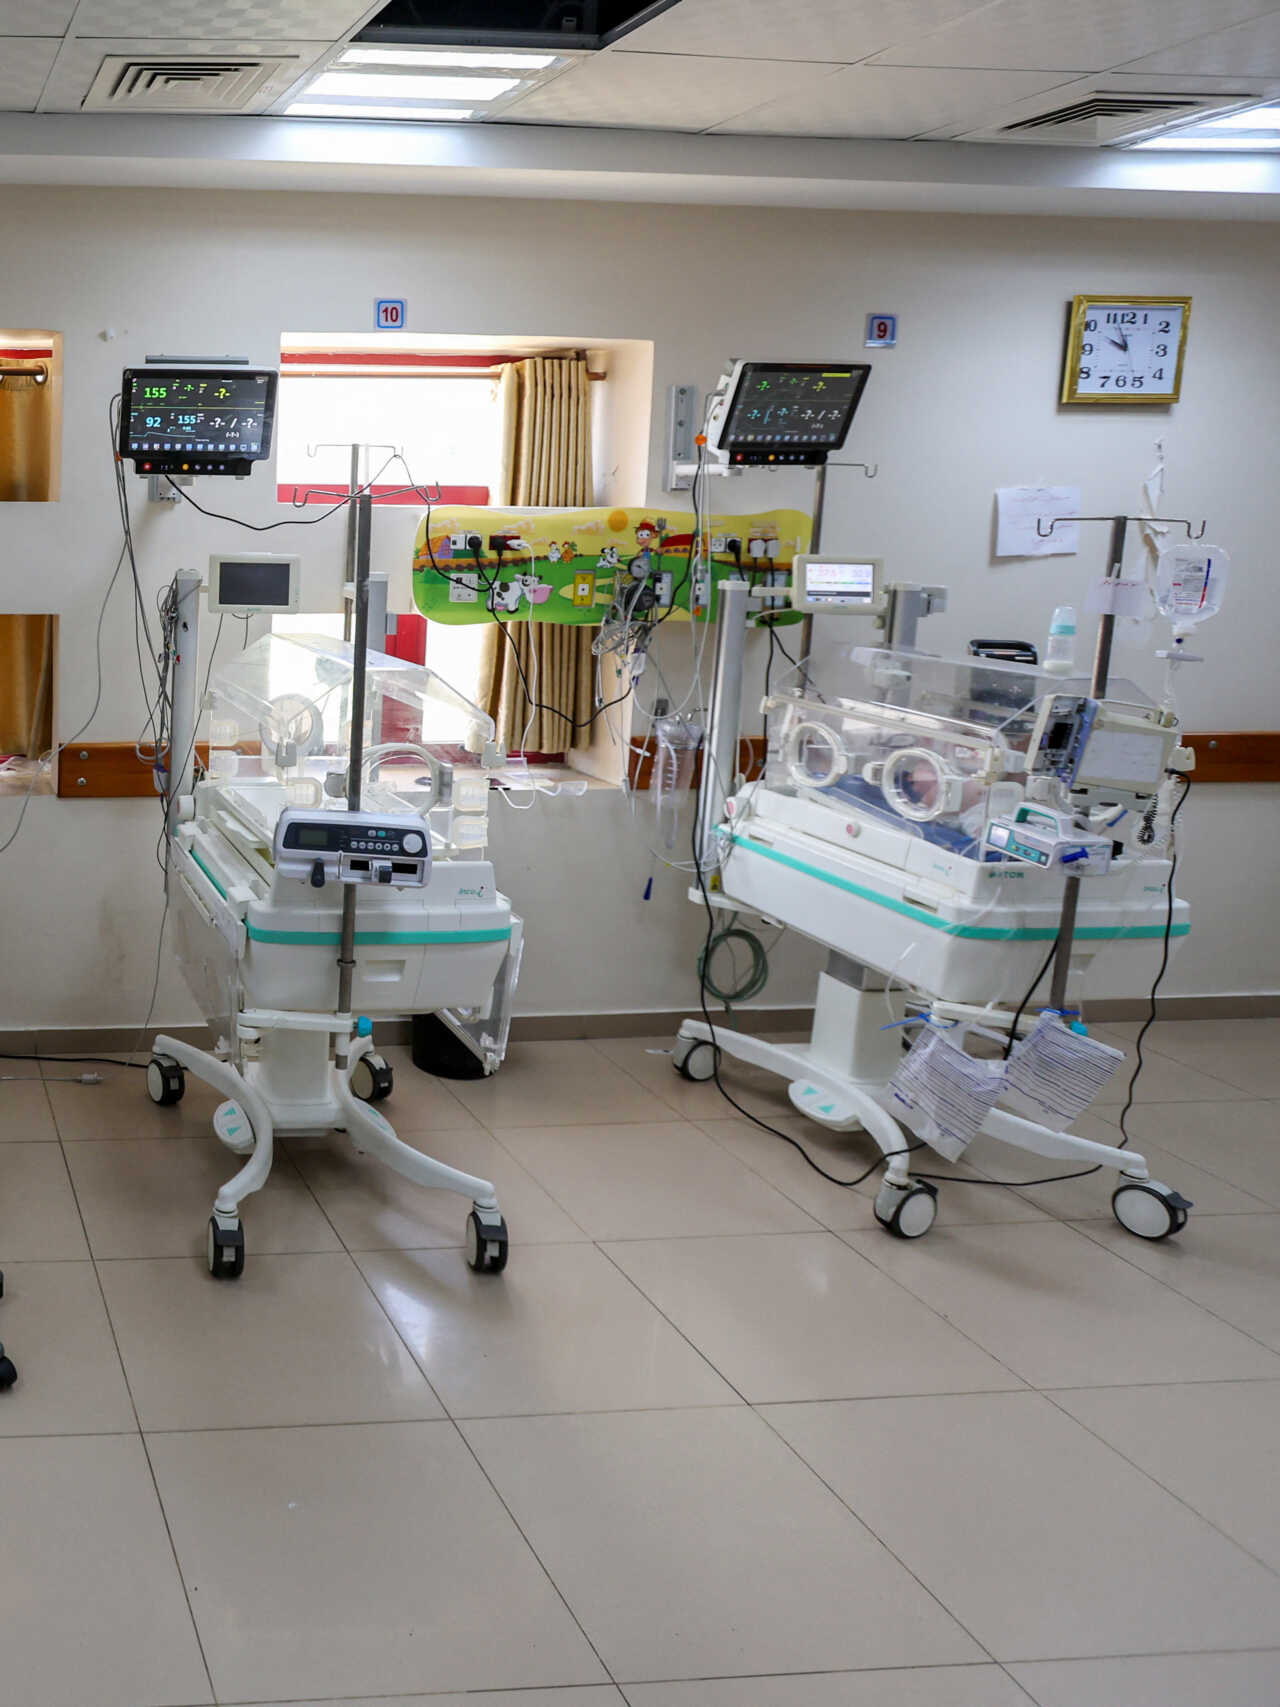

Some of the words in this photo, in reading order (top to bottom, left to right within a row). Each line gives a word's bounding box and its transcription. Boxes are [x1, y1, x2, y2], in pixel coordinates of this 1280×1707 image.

[382, 306, 399, 322] 10
[1106, 312, 1117, 324] 11
[1120, 311, 1137, 324] 12
[1143, 313, 1148, 325] 1
[876, 321, 888, 339] 9
[1158, 320, 1171, 334] 2
[1081, 343, 1093, 356] 9
[1155, 344, 1168, 357] 3
[1079, 366, 1091, 380] 8
[1152, 367, 1164, 380] 4
[1098, 375, 1111, 388] 7
[1115, 375, 1127, 388] 6
[1131, 376, 1144, 388] 5
[144, 387, 167, 398] 155
[146, 417, 161, 427] 92
[178, 415, 196, 424] 155
